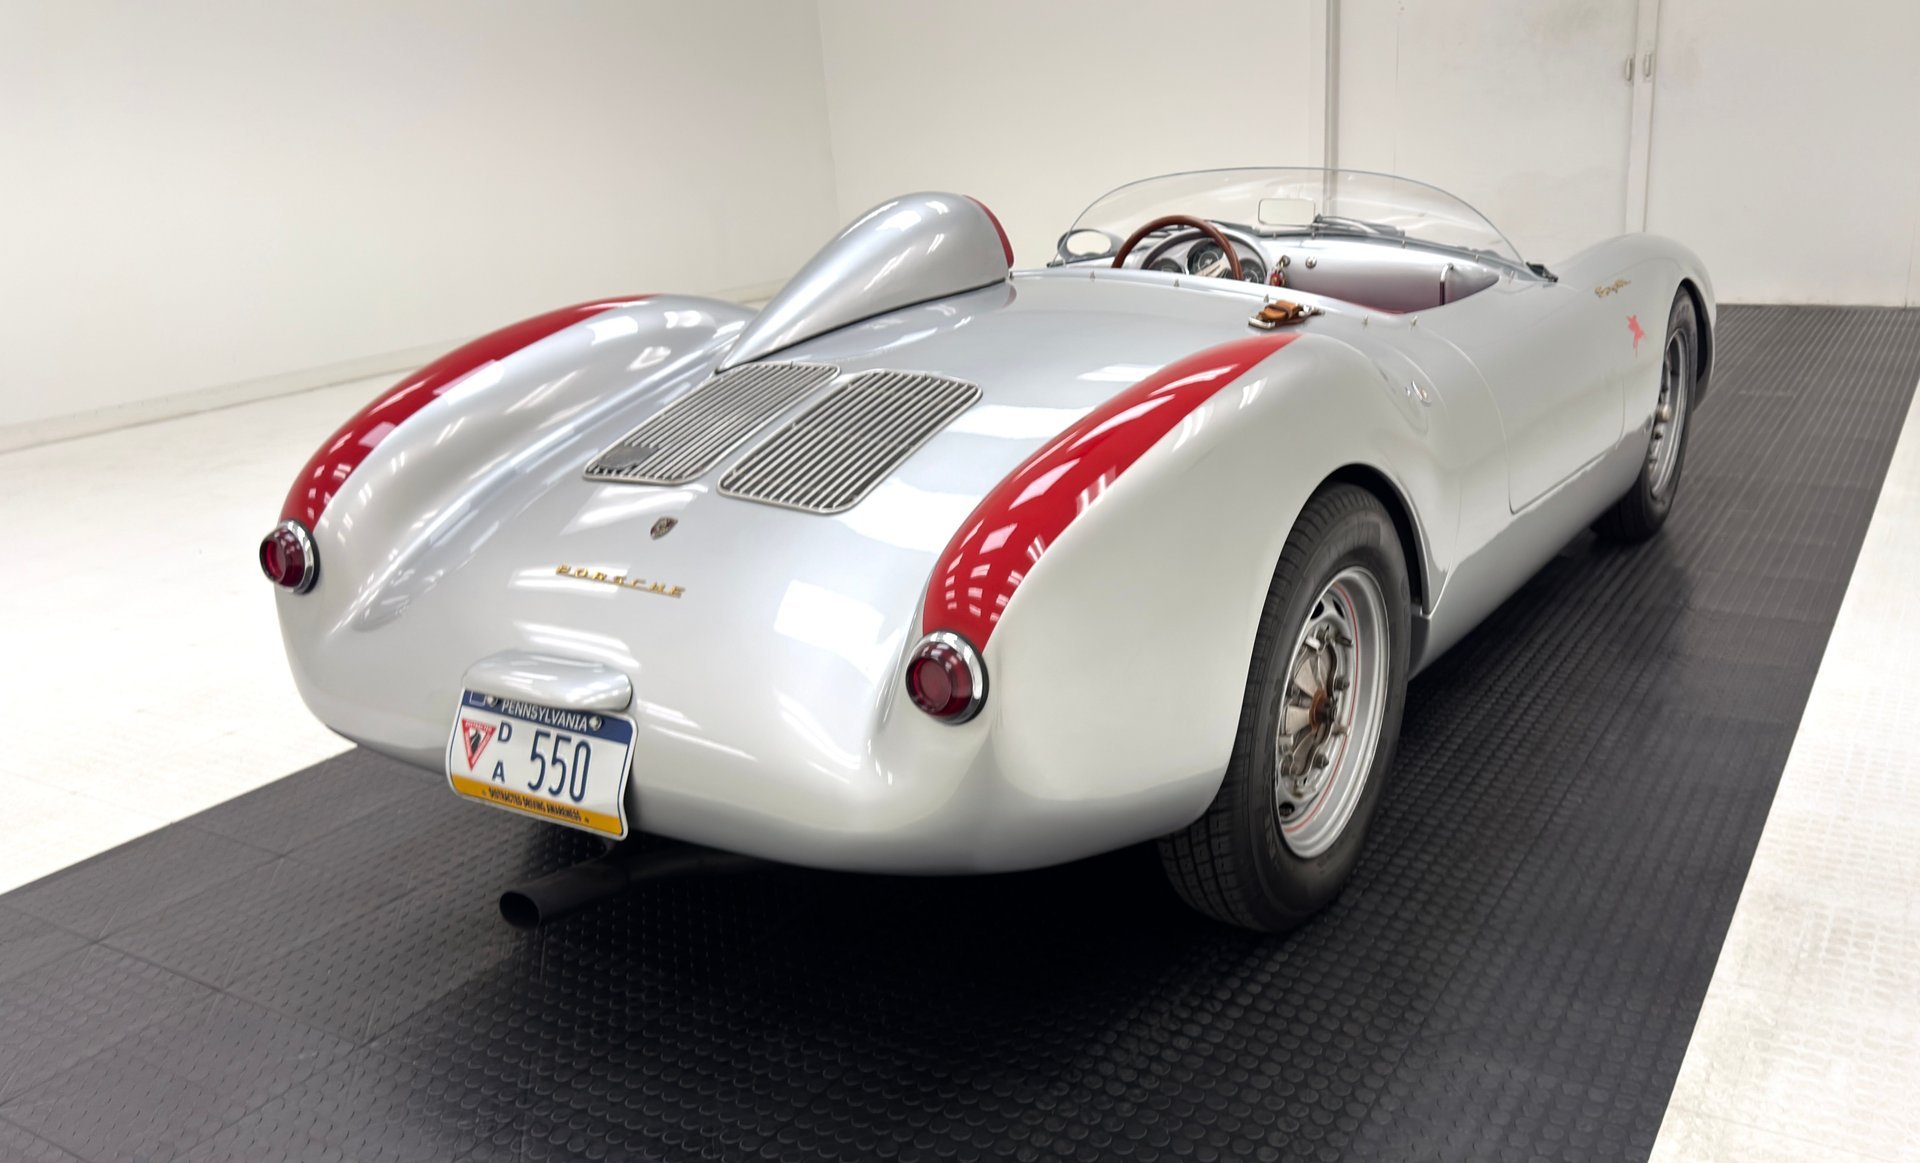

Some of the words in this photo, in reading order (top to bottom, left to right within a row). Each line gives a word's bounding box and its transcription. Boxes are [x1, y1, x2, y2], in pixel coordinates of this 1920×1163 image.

[556, 564, 686, 598] PORSCHE
[497, 721, 513, 743] D
[501, 698, 588, 732] PENNSYLVANIA
[491, 760, 506, 784] A
[527, 729, 592, 803] 550
